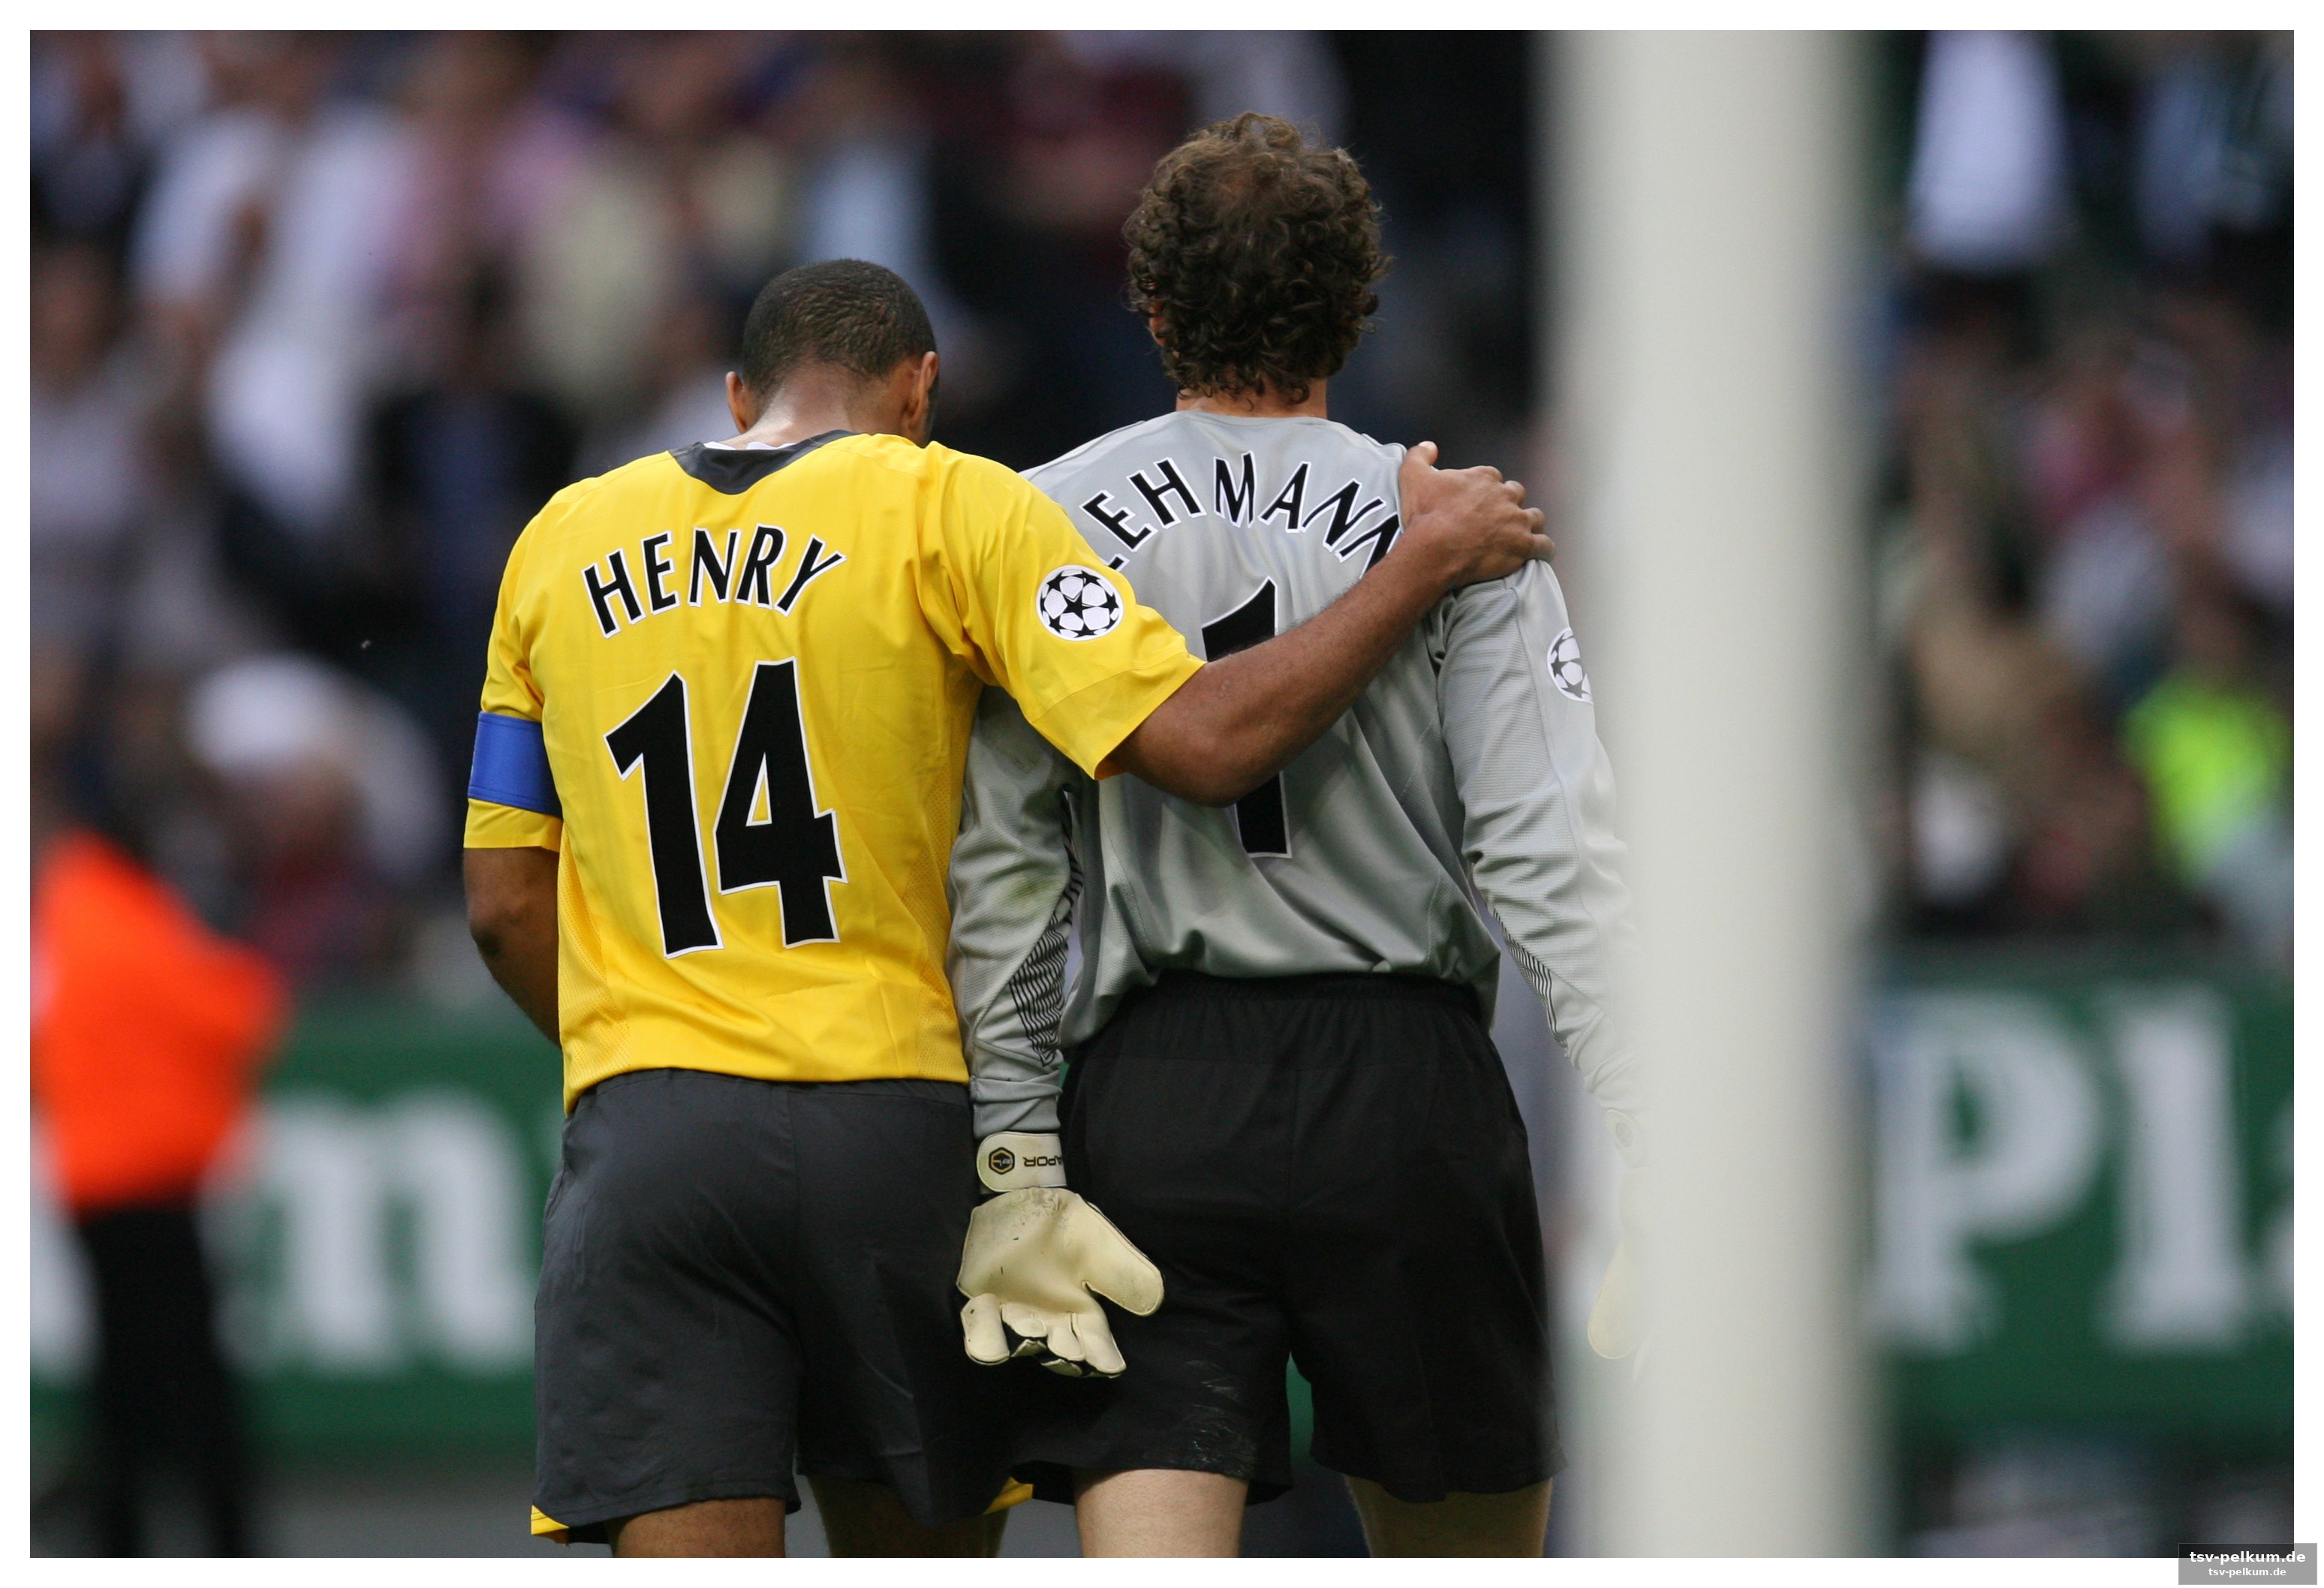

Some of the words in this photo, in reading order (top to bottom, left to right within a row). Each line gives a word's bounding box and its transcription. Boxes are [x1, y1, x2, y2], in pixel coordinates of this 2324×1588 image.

[1079, 451, 1401, 579] EHMANN
[582, 523, 847, 639] HENRY
[604, 656, 848, 959] 14
